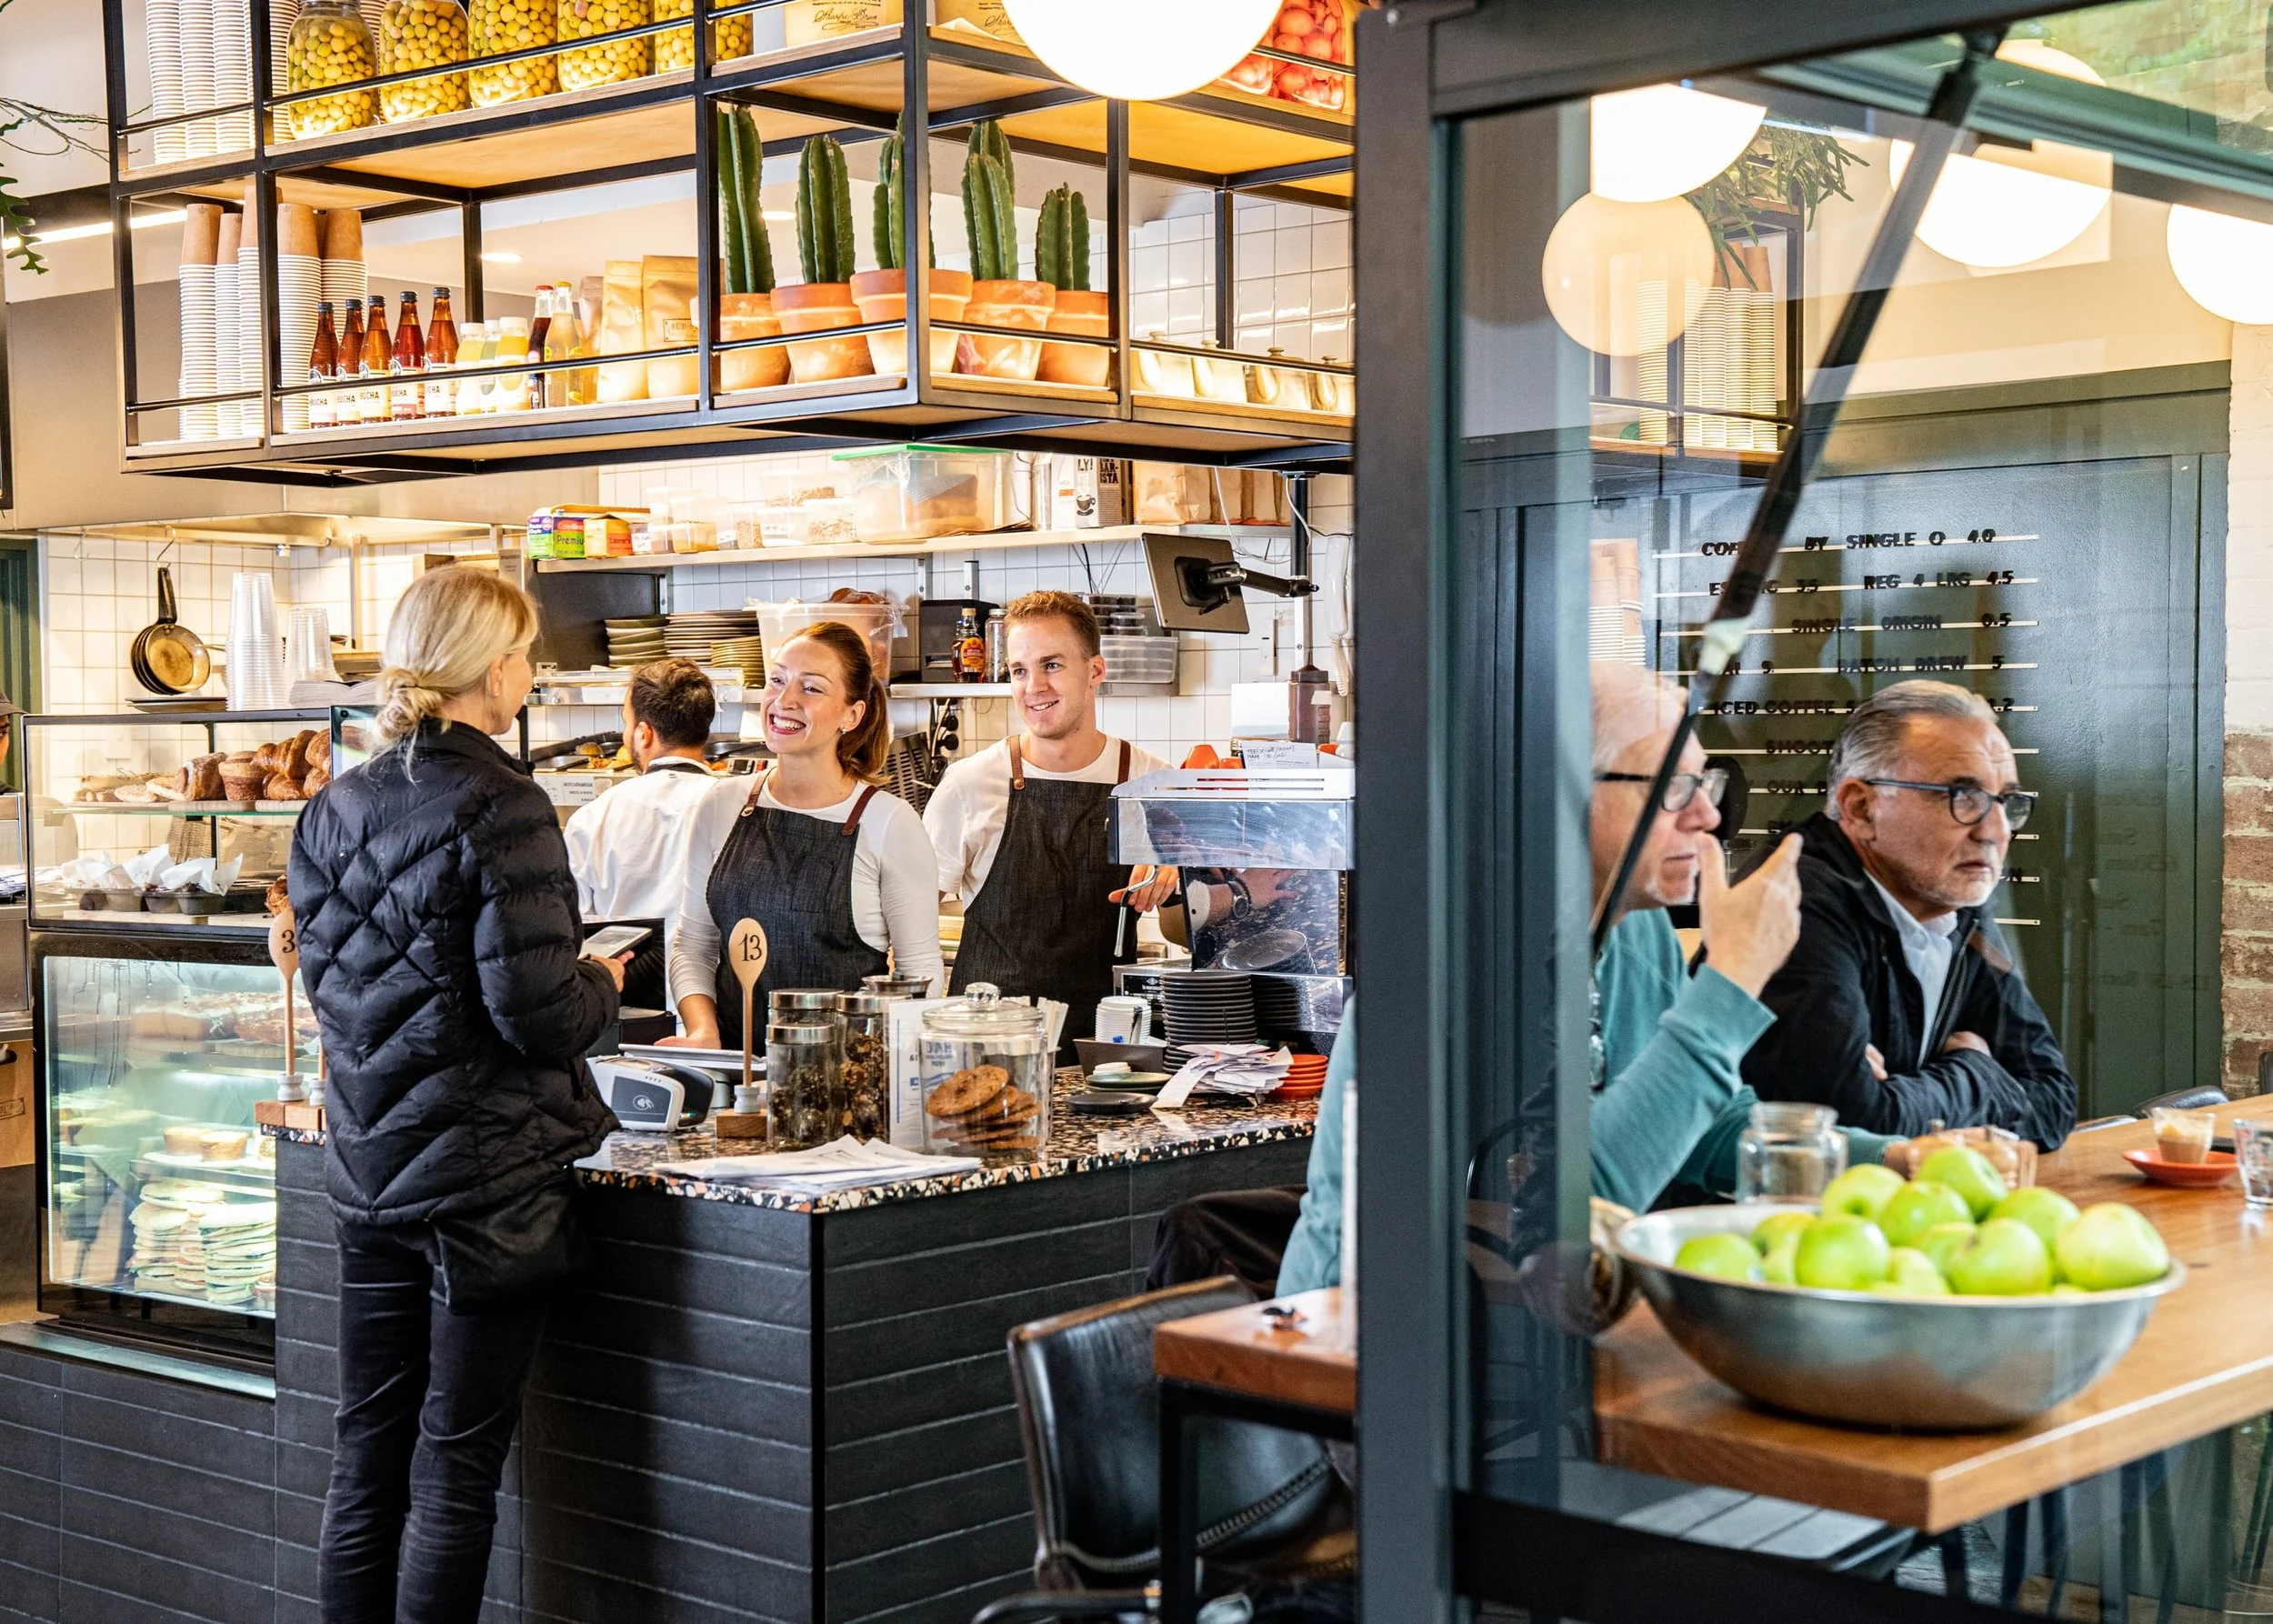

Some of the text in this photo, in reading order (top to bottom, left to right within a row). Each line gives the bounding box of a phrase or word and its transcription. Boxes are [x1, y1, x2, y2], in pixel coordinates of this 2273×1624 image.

[556, 534, 585, 546] Premiu
[1804, 536, 1829, 550] BY
[1847, 532, 1917, 549] SINGLE
[1928, 531, 1947, 546] O
[1967, 528, 1997, 543] 4.0
[1864, 574, 1901, 589] REG
[1913, 573, 1925, 586] 4
[1937, 571, 1972, 586] LRG
[1986, 570, 2015, 585] 4.5
[1791, 617, 1856, 634] SINGLE
[1881, 615, 1941, 630] ORIGIN
[1914, 656, 1968, 672] BREW
[1991, 656, 2006, 670] 5
[1765, 698, 1835, 716] COFFEE
[1767, 779, 1805, 795] OUR
[282, 929, 295, 954] 3
[737, 933, 762, 962] 13
